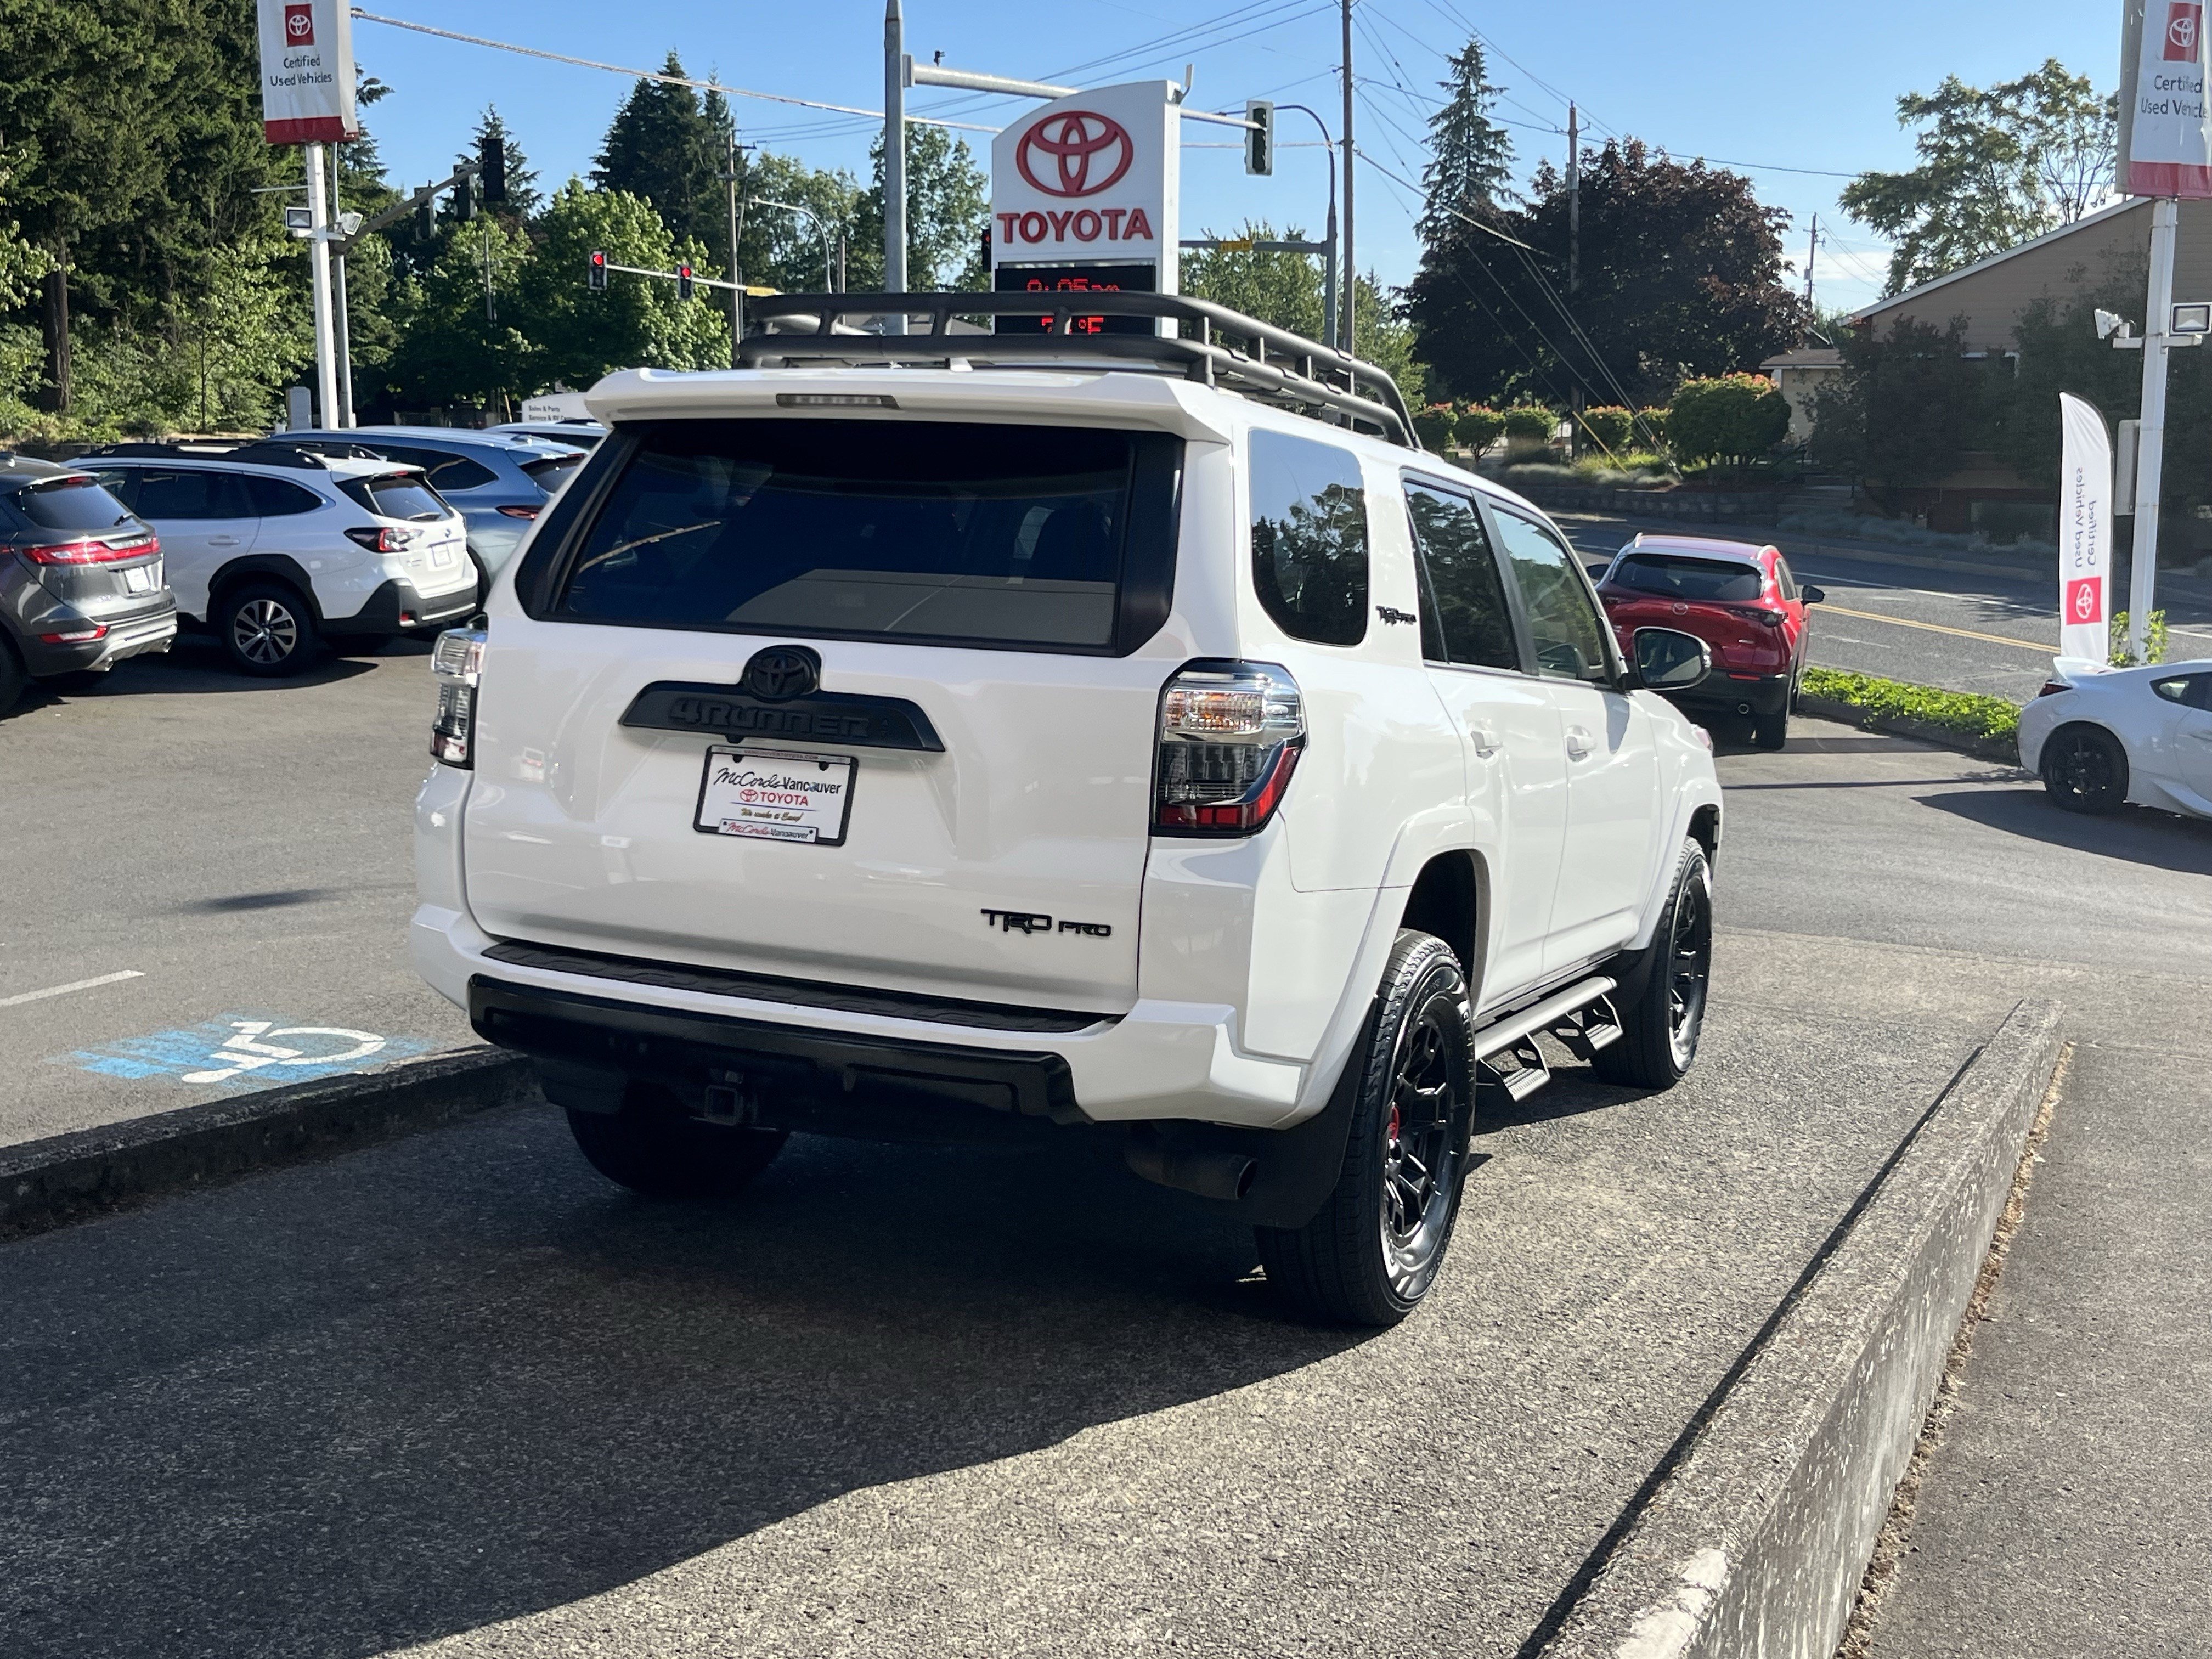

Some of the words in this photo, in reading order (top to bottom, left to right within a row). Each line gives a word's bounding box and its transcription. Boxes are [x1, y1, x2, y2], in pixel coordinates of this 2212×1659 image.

[283, 54, 321, 69] Certified
[270, 73, 296, 87] Used
[297, 71, 332, 84] Vehicles
[2141, 97, 2169, 115] Used
[996, 208, 1154, 244] TOYOTA
[668, 697, 870, 738] 4RUNNER
[760, 791, 809, 806] TOYOTA
[980, 908, 1052, 934] TRD
[1058, 920, 1112, 936] PRO
